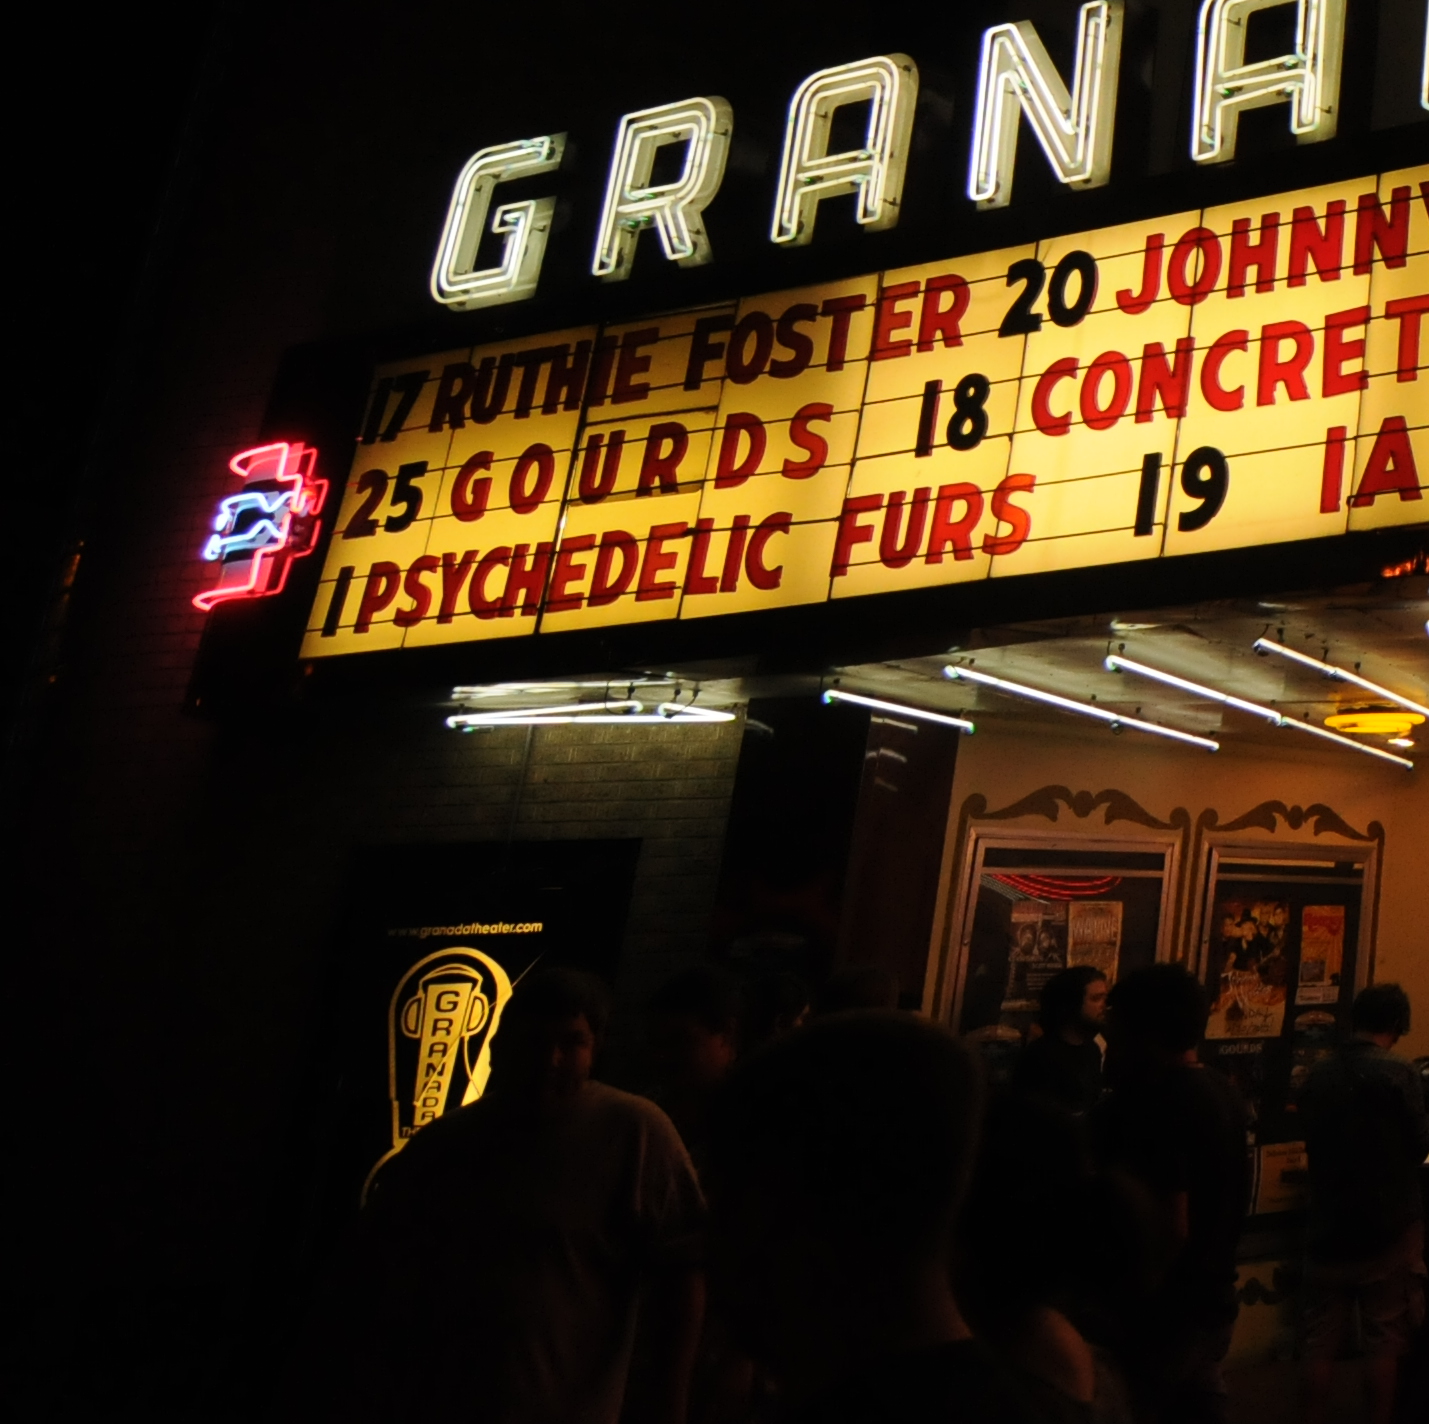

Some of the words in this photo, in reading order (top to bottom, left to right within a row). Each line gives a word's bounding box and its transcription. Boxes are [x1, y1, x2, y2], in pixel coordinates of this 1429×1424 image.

[362, 369, 428, 445] 17
[429, 327, 660, 433] RUTHIE
[684, 273, 970, 391] FOSTER
[999, 250, 1097, 338] 20
[321, 566, 354, 636] 1
[353, 512, 792, 634] PSYCHEDELIC
[831, 474, 1035, 577] FURS
[1134, 444, 1229, 533] 19
[342, 461, 427, 540] 25
[450, 402, 833, 521] GOURDS
[915, 372, 988, 457] 18
[387, 921, 544, 939] www.granadatheater.com
[420, 990, 460, 1121] GRANADA
